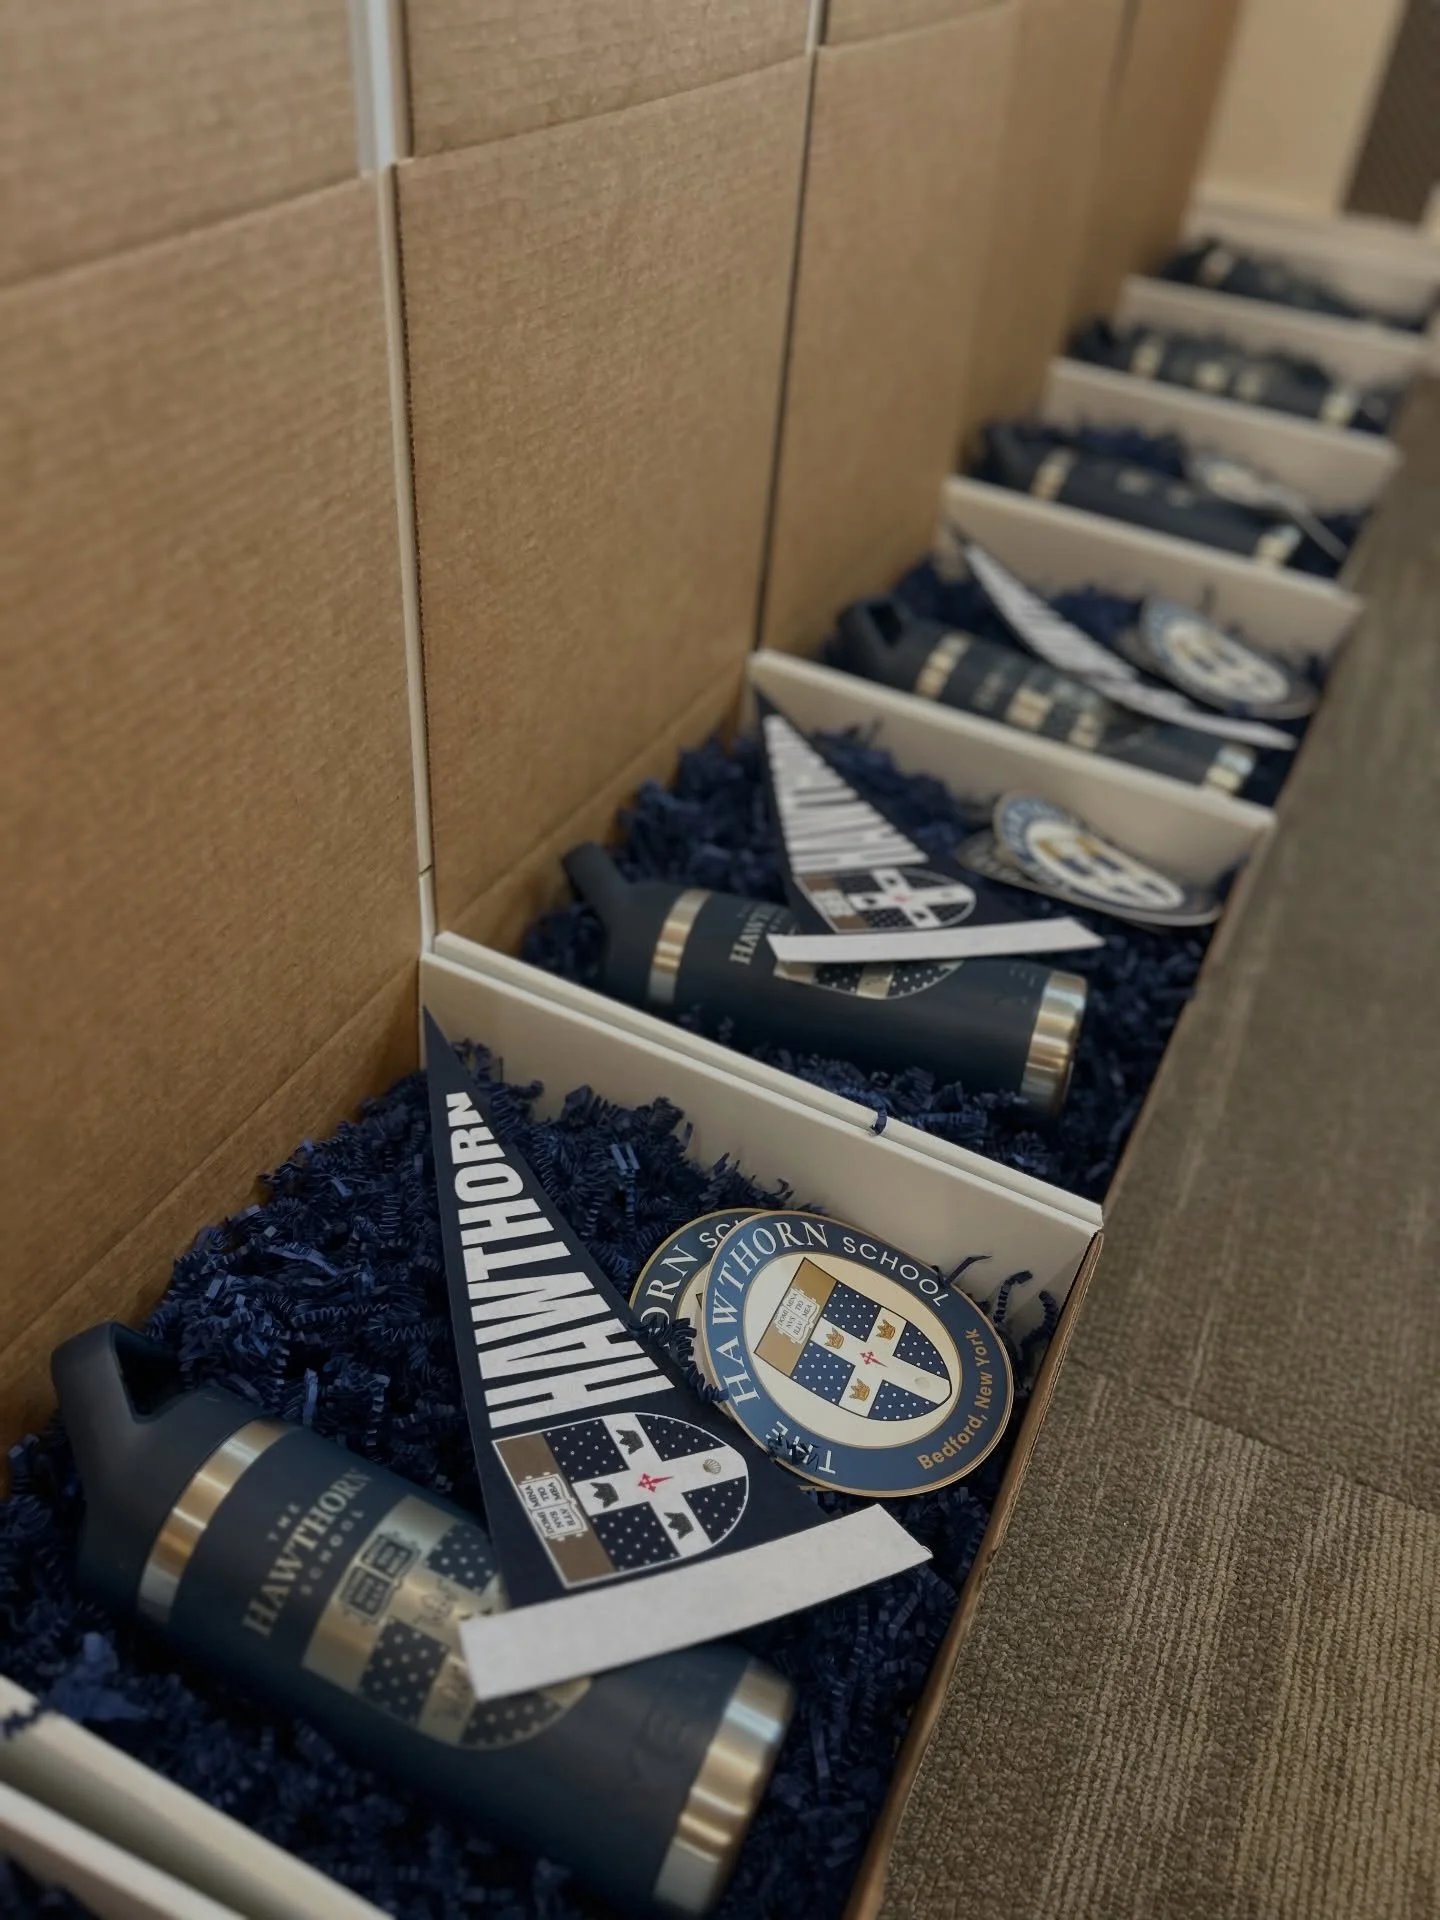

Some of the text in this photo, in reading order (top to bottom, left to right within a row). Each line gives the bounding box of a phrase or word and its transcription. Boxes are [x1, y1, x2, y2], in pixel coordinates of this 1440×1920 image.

[446, 1092, 675, 1429] HAWTHORN
[712, 1221, 829, 1406] HAWTHORN
[842, 1236, 949, 1307] SCHOOL
[916, 1328, 993, 1470] Bedford, New York
[241, 1467, 373, 1639] HAWTHORN
[525, 1485, 541, 1507] MINA
[538, 1487, 549, 1501] TIO
